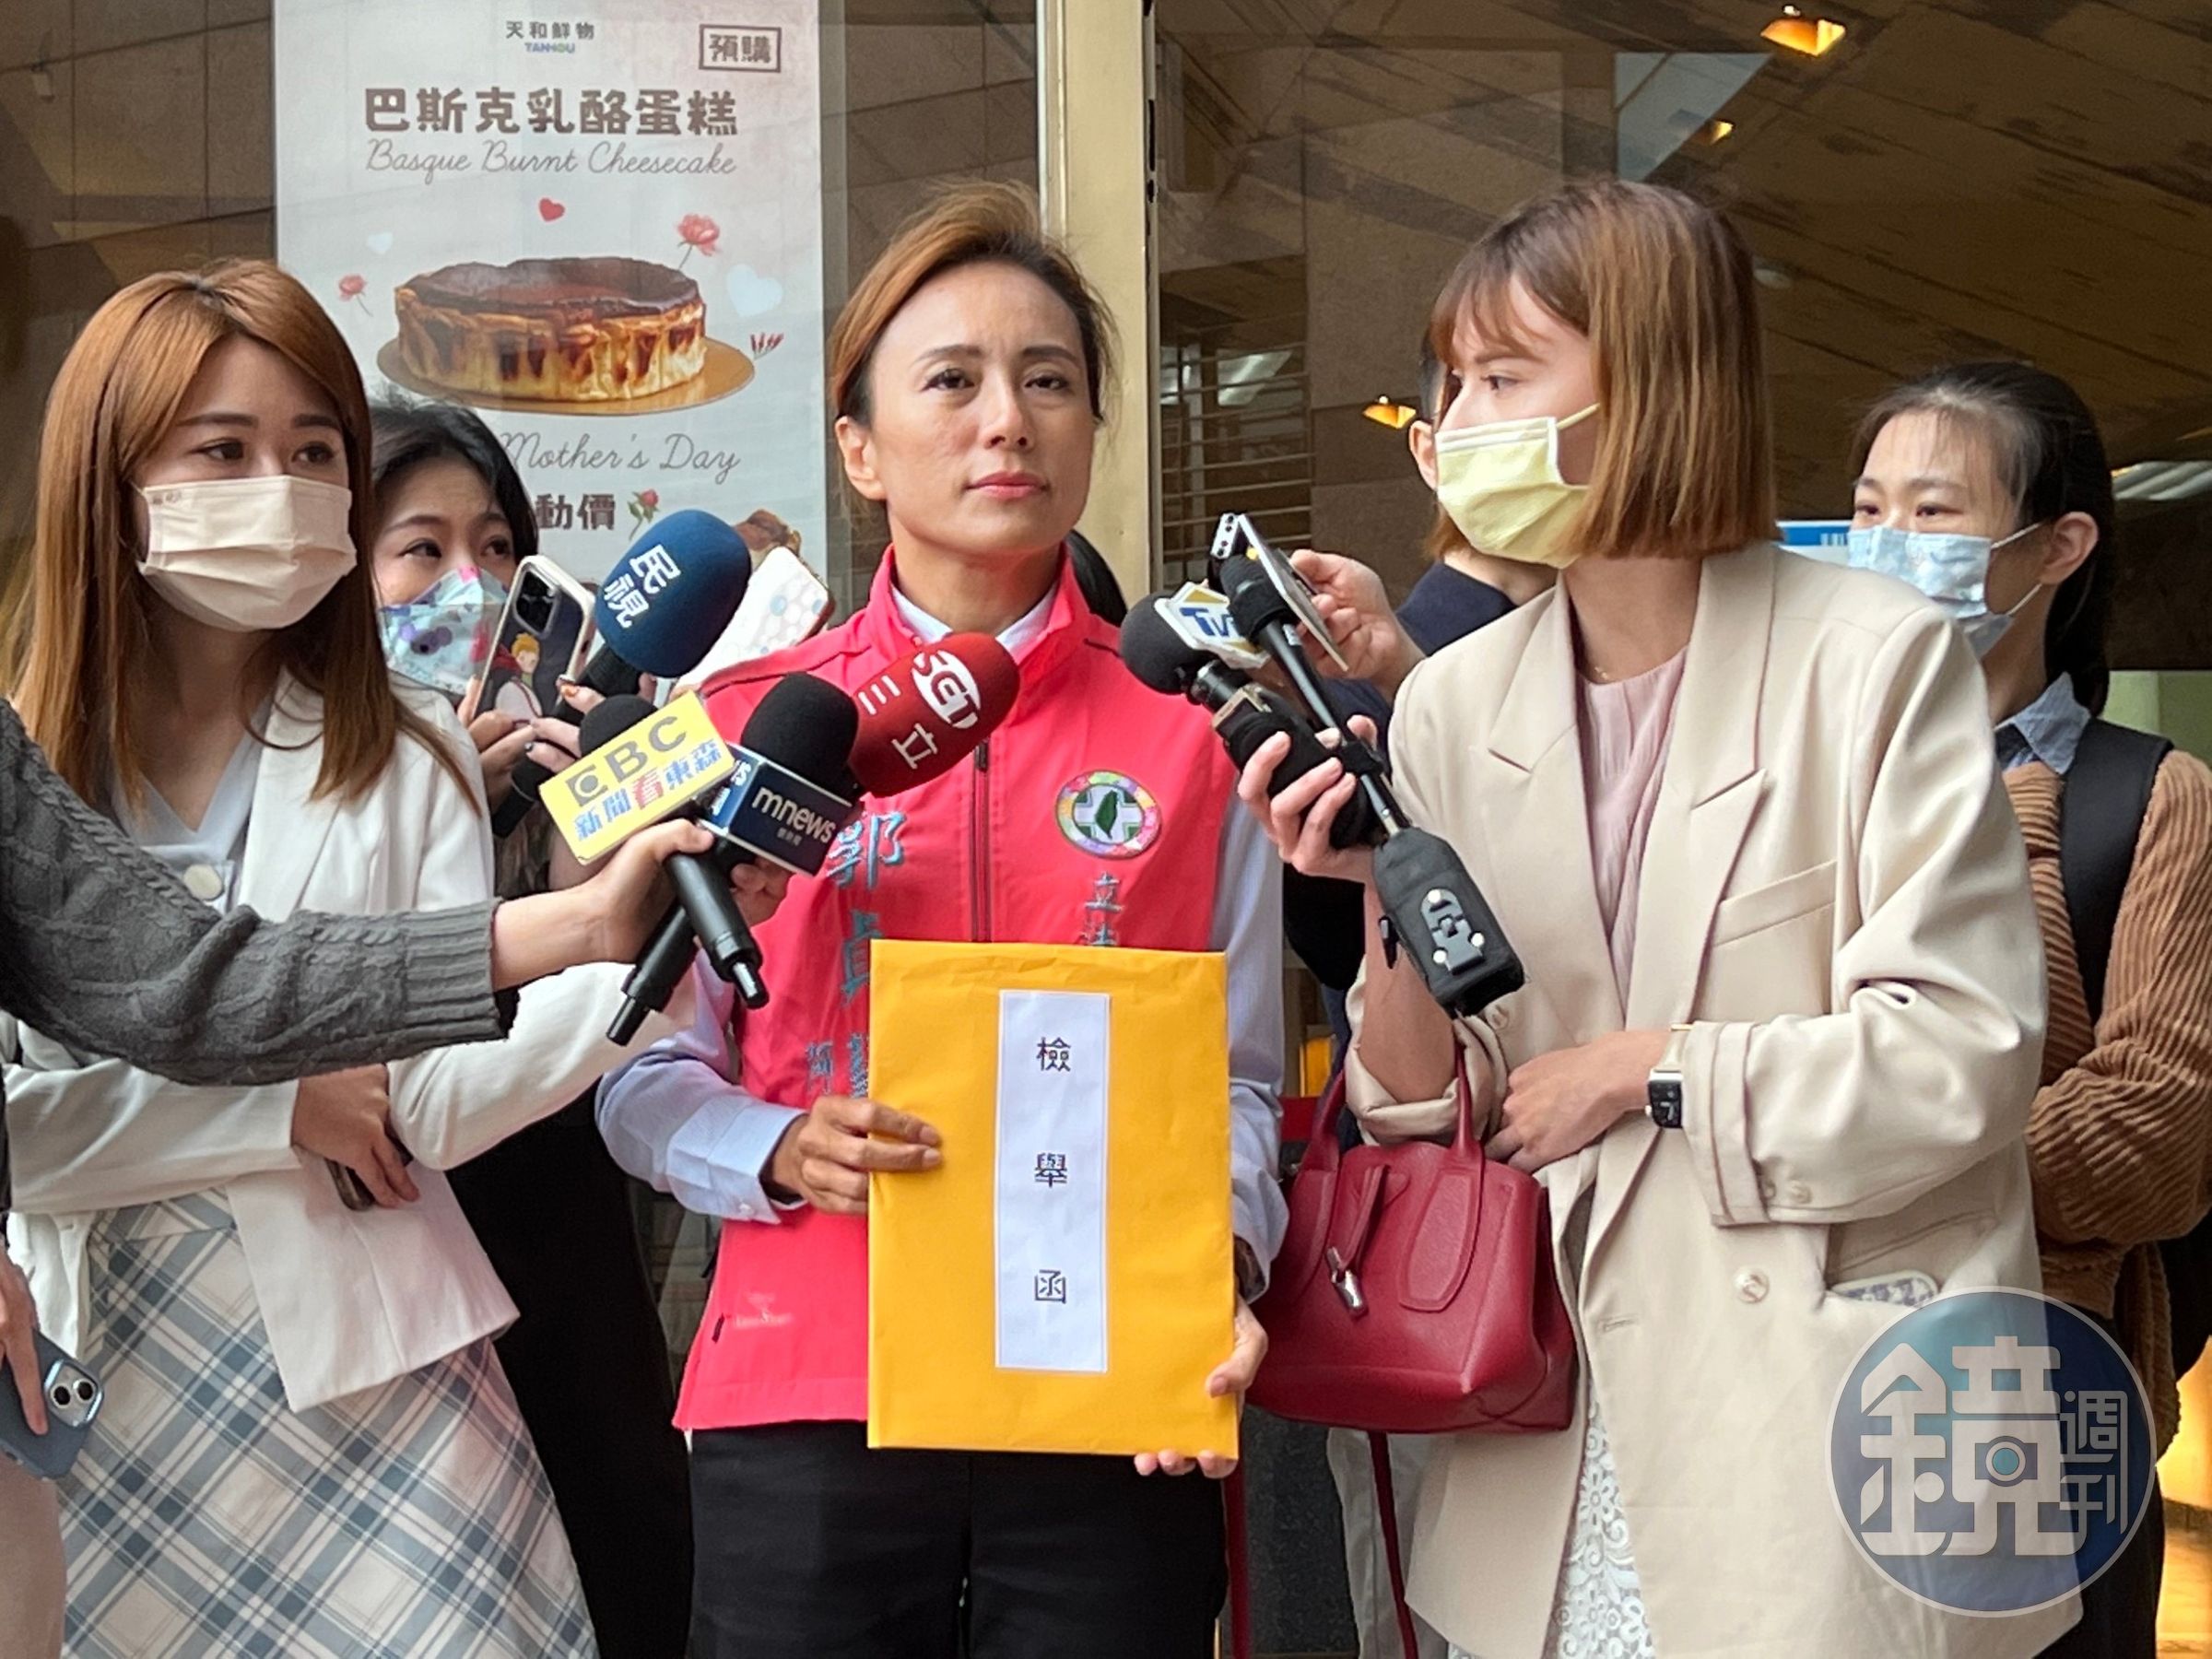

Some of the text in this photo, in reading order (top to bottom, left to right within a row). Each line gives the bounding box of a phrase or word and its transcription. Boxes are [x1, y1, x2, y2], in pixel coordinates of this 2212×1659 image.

[506, 20, 595, 40] 天和鮮物
[709, 34, 771, 64] 預購
[366, 87, 737, 135] 巴斯克乳酪蛋糕
[366, 138, 736, 184] Basque Burnt Cheesecake
[499, 432, 741, 485] Mother's Day
[535, 493, 615, 530] 動價
[604, 544, 681, 629] 民視
[858, 675, 938, 770] 三立
[751, 786, 836, 843] mnews
[1034, 1036, 1072, 1304] 檢舉函
